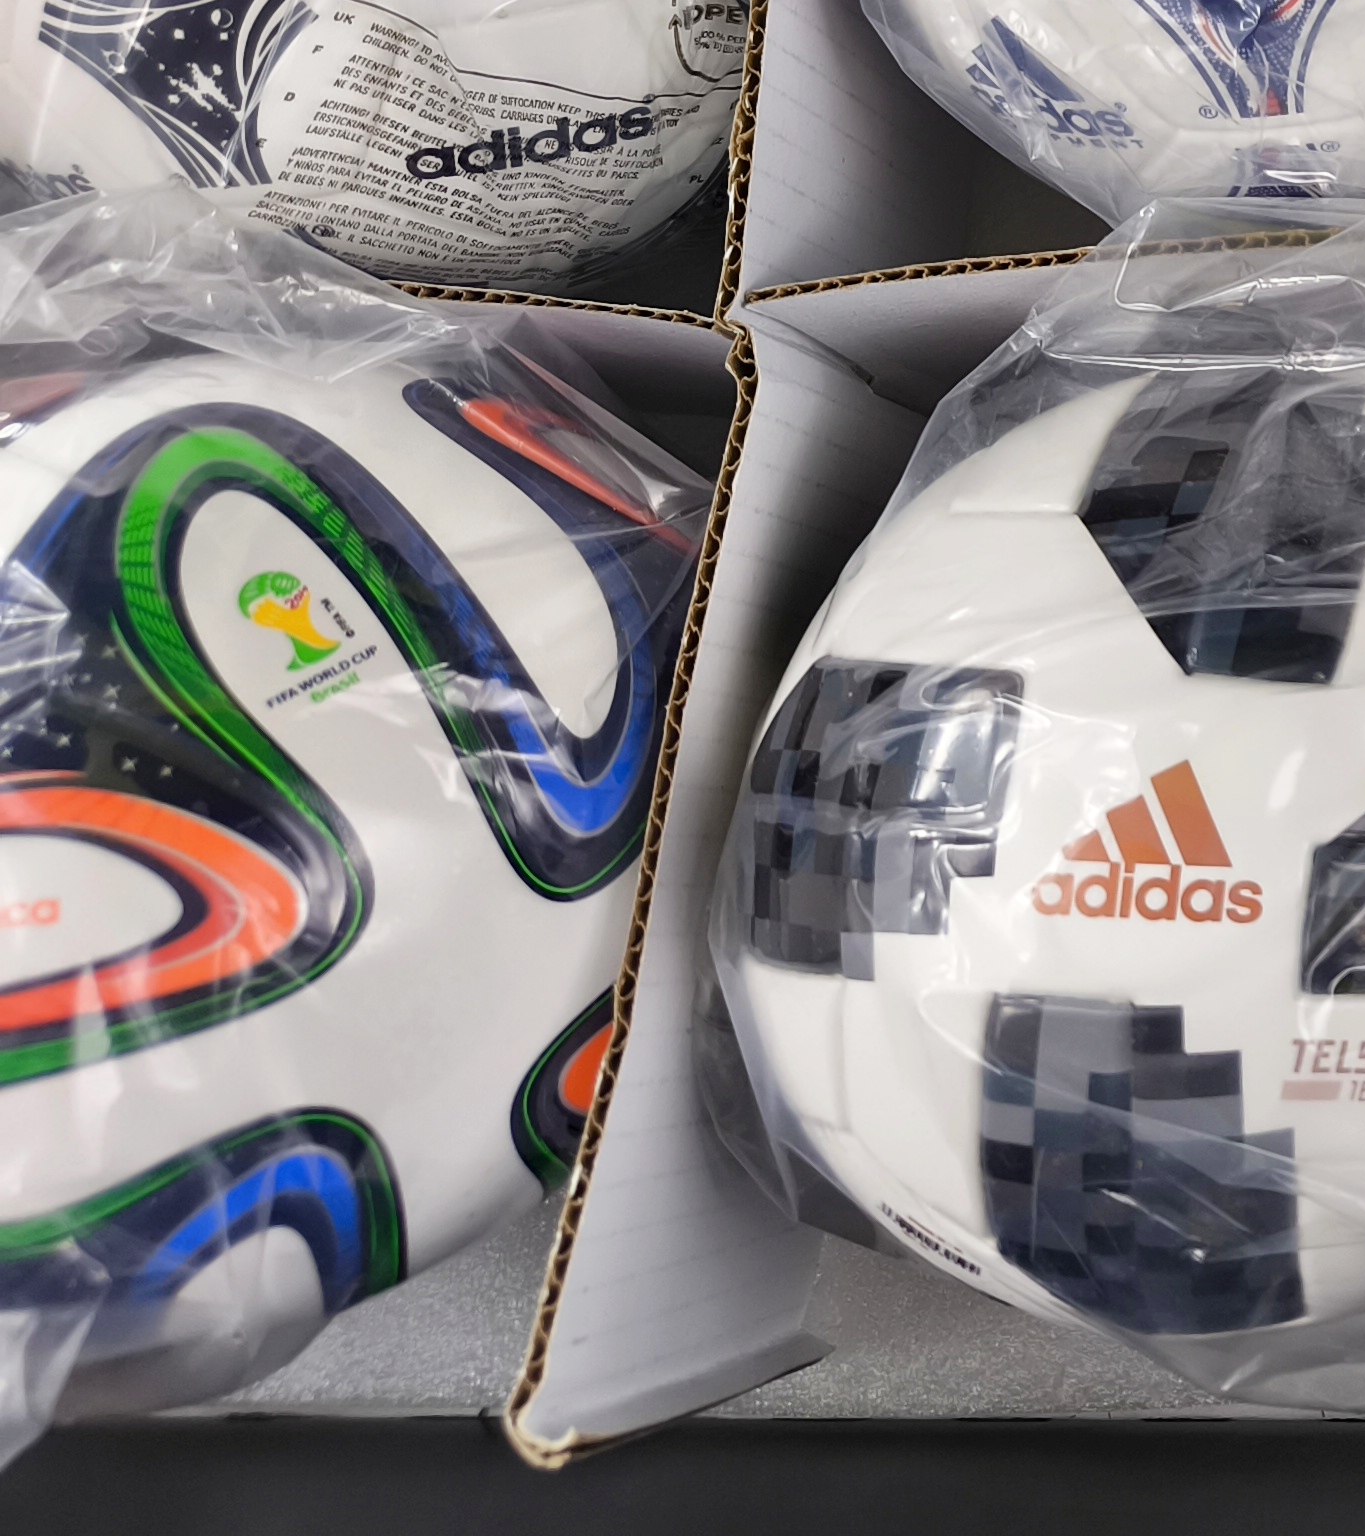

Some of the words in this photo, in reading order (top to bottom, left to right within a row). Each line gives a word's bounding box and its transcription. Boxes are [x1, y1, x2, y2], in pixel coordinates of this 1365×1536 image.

[334, 11, 355, 24] UK
[370, 23, 419, 48] WARNING!
[349, 54, 403, 78] ATTENTION
[413, 77, 427, 89] CE
[428, 84, 448, 99] SAC
[413, 55, 428, 65] DO
[430, 64, 448, 76] NOT
[333, 78, 347, 88] NE
[349, 81, 370, 95] PAS
[372, 90, 417, 112] UTILISER
[419, 108, 446, 125] DANS
[341, 66, 362, 78] DES
[363, 73, 408, 94] ENFANTS
[410, 89, 424, 100] ET
[425, 97, 446, 113] DES
[488, 93, 499, 104] OF
[501, 95, 555, 111] SUFFOCATION
[557, 103, 582, 114] KEEP
[320, 99, 371, 118] ACHTUNG!
[372, 113, 411, 133] DIESEN
[411, 129, 446, 148] BEUTEL
[406, 106, 653, 178] adidas
[278, 171, 292, 182] DE
[327, 179, 338, 188] NI
[341, 183, 387, 200] PARQUES
[450, 210, 474, 224] ESTA
[294, 160, 326, 173] NIÑOS
[327, 165, 351, 178] PARA
[354, 171, 389, 188] EVITAR
[406, 187, 449, 205] PELIGRO
[450, 200, 465, 209] DE
[367, 162, 422, 186] MANTENER
[424, 182, 448, 194] ESTA
[451, 188, 483, 204] BOLSA
[256, 200, 314, 221] SACCHETTO
[315, 215, 361, 230] LONTANO
[363, 224, 394, 238] DALLA
[397, 231, 438, 248] PORTATA
[441, 243, 460, 254] DEI
[330, 203, 350, 215] PER
[352, 206, 391, 223] EVITARE
[406, 220, 454, 240] PERICOLO
[360, 236, 416, 255] SACCHETTO
[418, 249, 440, 260] NON
[298, 659, 351, 691] WORLD
[351, 644, 378, 665] CUP
[1032, 862, 1263, 923] adidas
